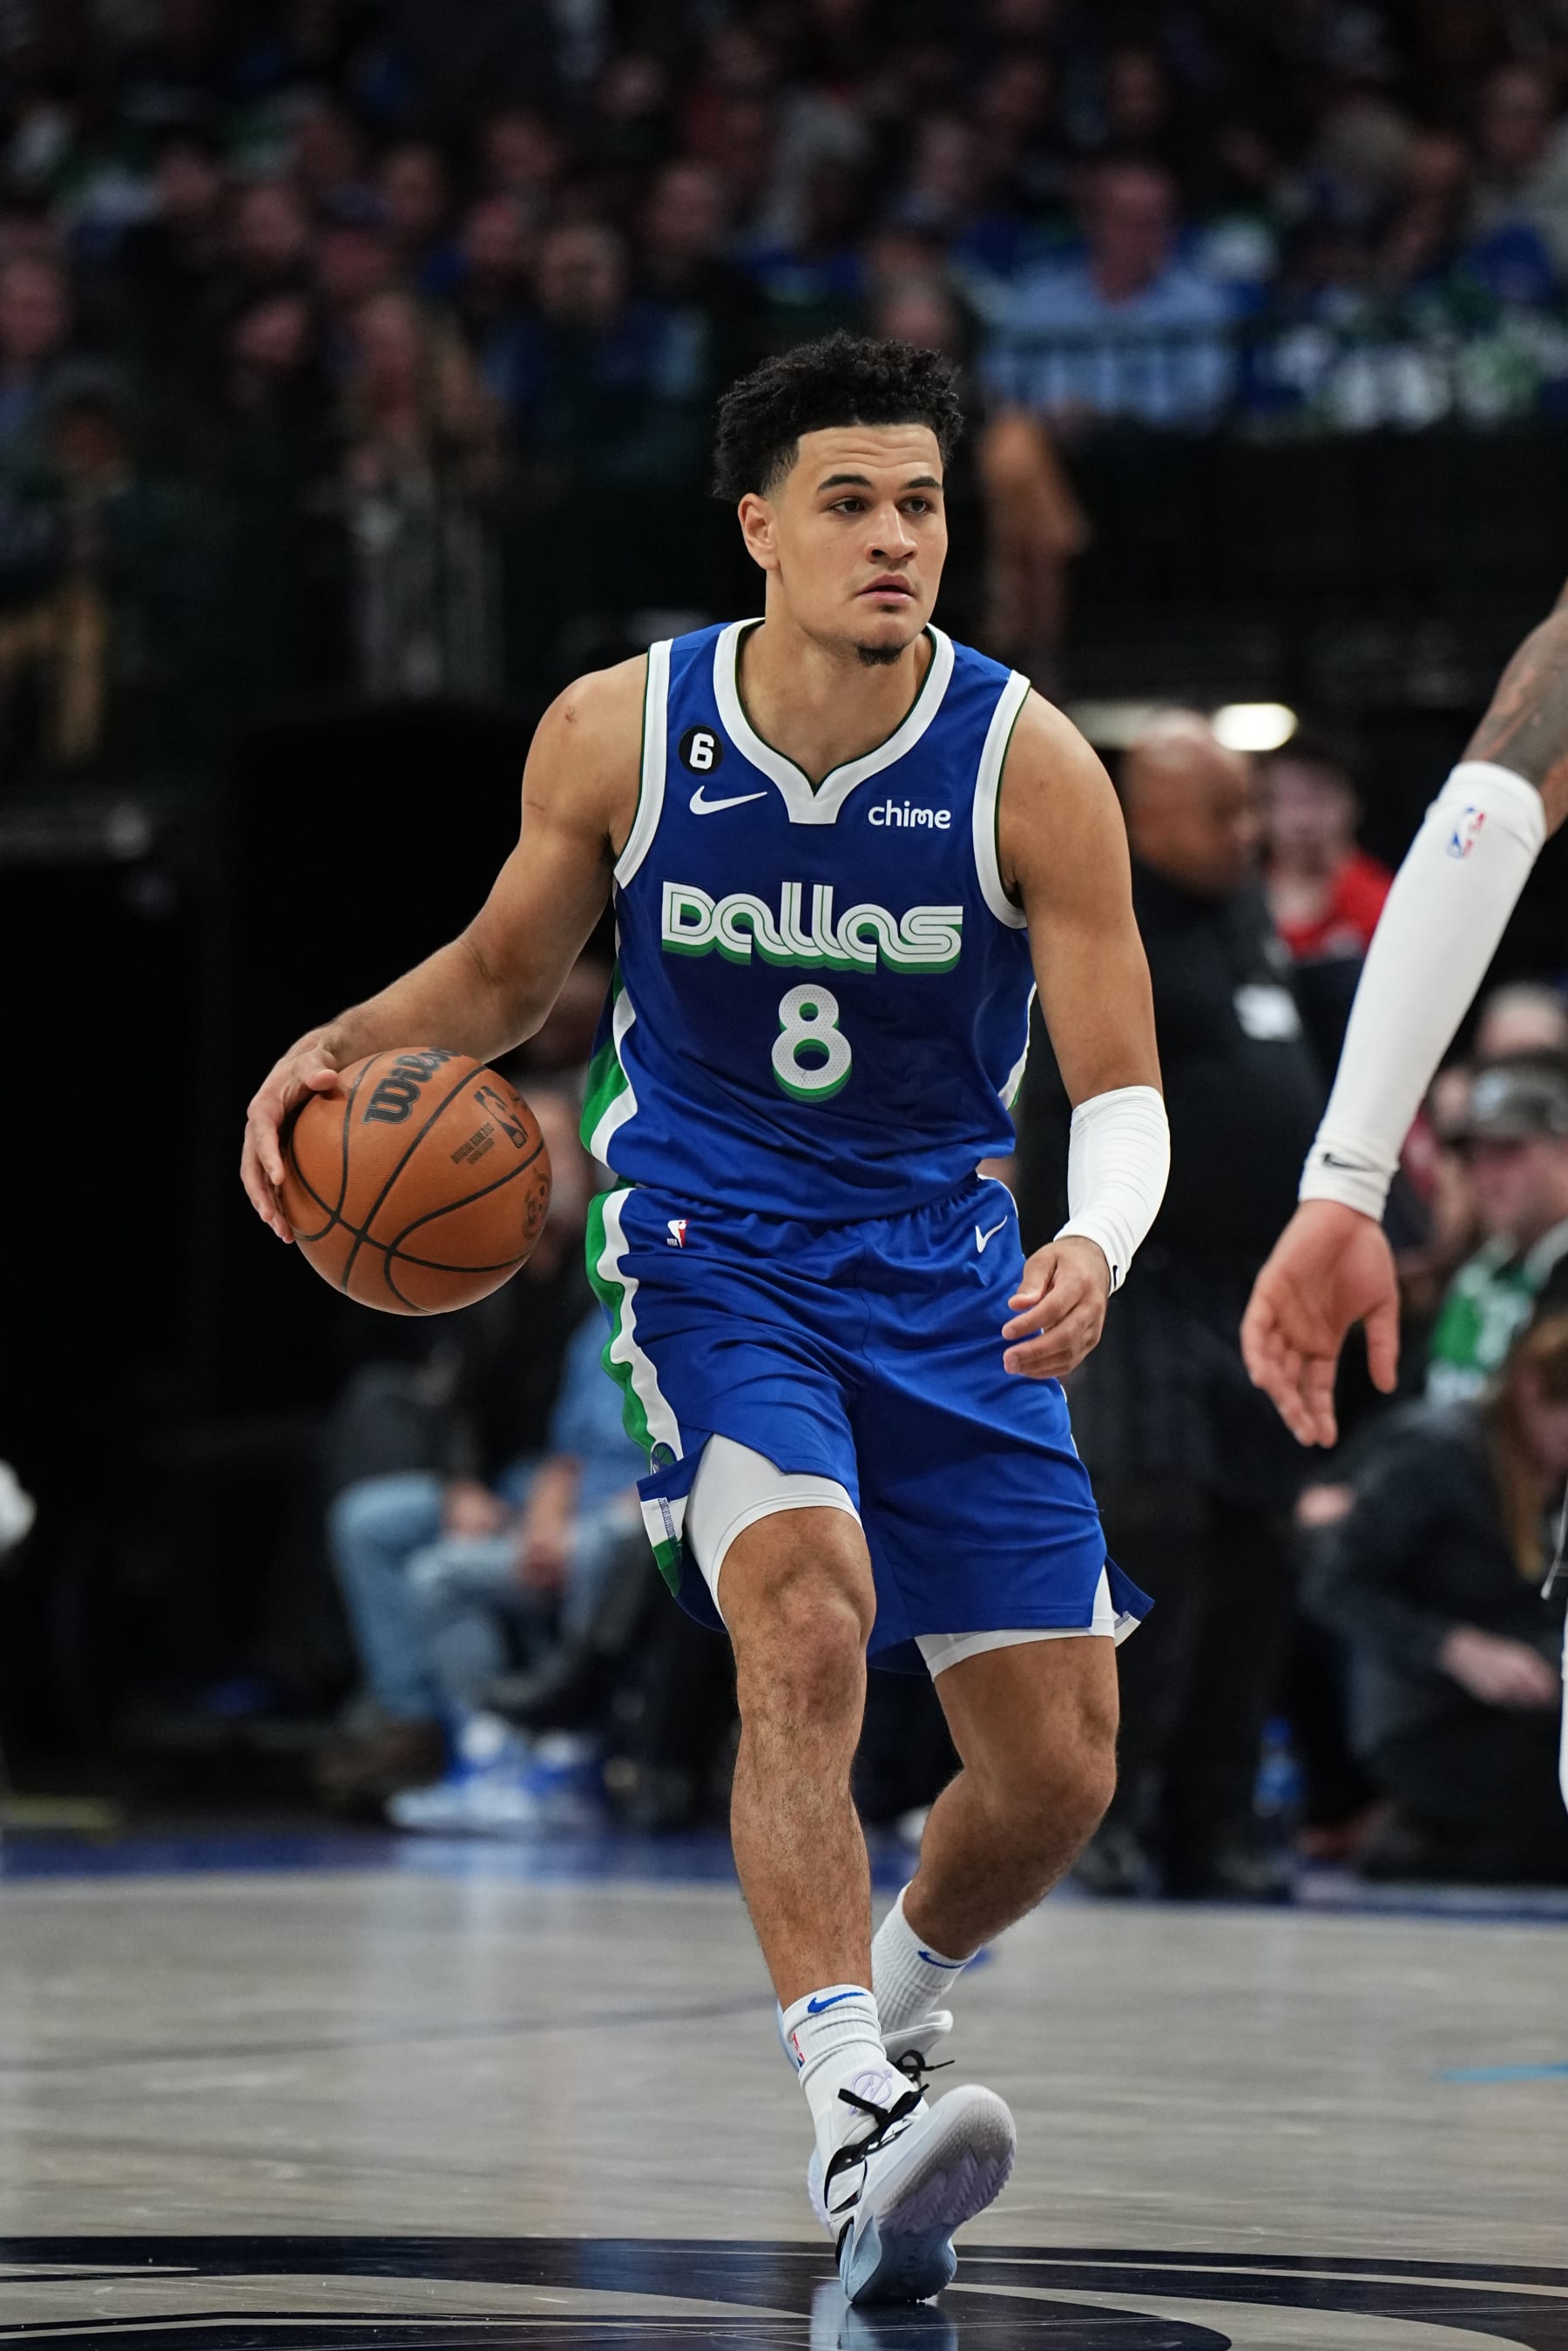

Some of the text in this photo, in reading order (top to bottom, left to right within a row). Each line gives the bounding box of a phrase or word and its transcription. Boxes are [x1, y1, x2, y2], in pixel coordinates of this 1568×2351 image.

[689, 733, 714, 770] 6
[868, 800, 951, 828] chime
[662, 882, 963, 974] Dallas
[772, 983, 852, 1103] 8
